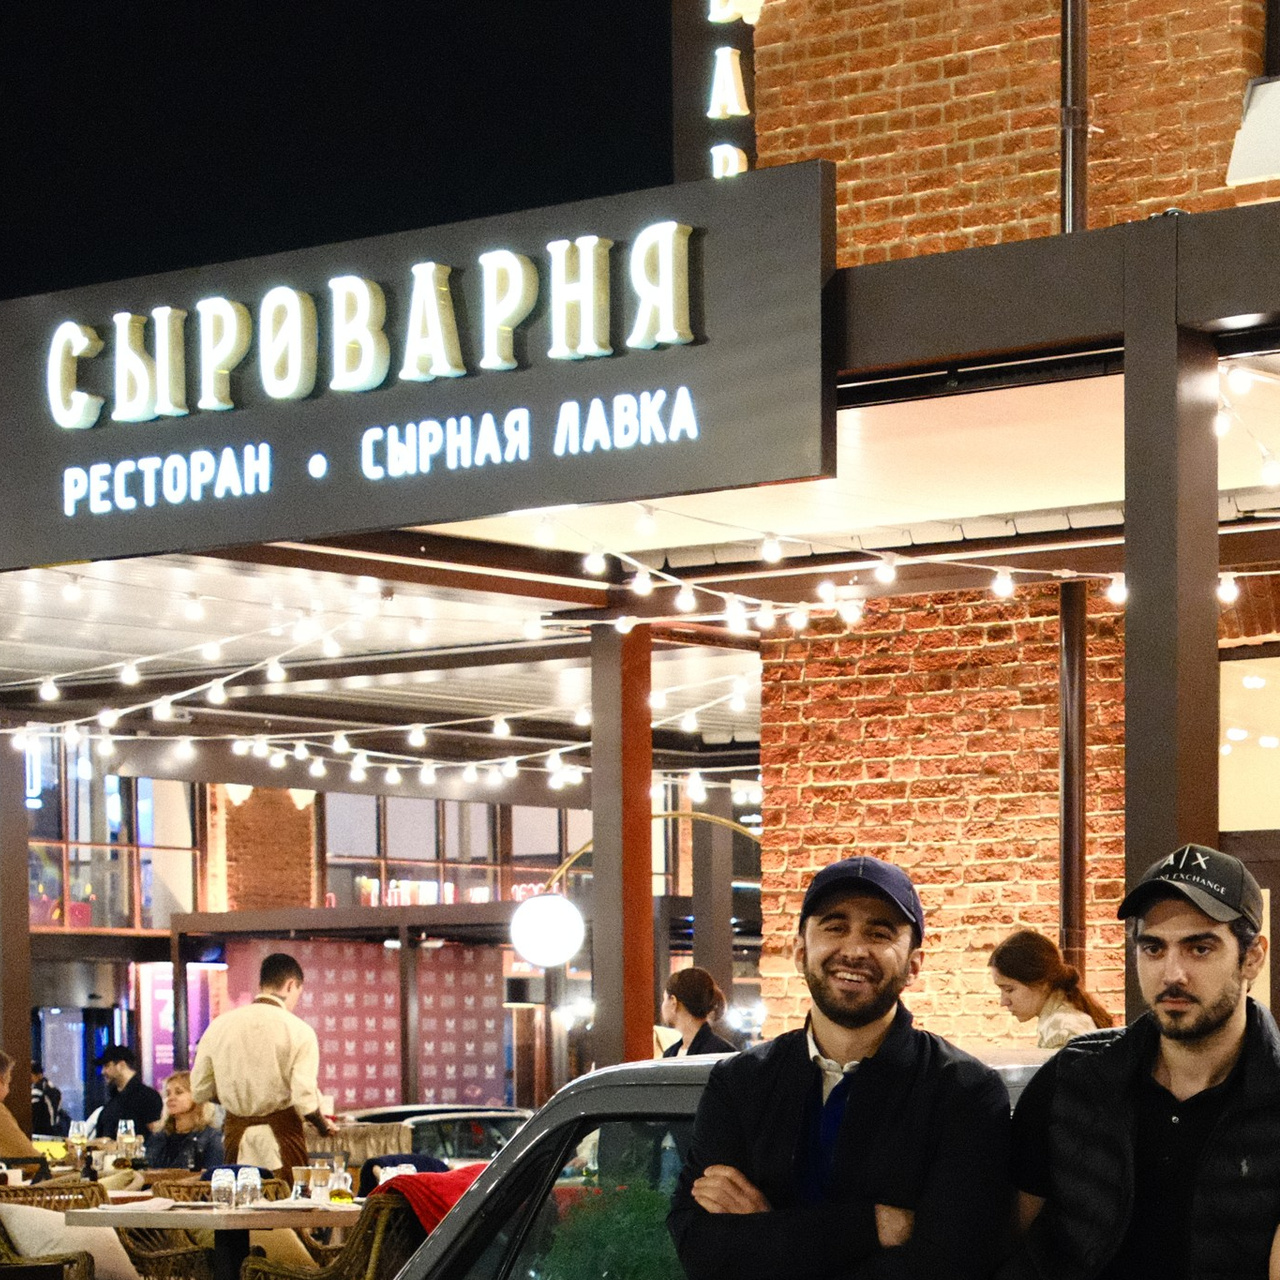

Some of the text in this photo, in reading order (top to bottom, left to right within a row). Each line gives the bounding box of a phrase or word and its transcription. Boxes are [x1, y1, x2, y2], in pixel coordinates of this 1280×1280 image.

[47, 220, 694, 430] СЫРОВАРНЯ
[63, 386, 699, 517] РЕСТОРАН СЫРНАЯ ЛАВКА
[1172, 872, 1227, 896] EXCHANGE
